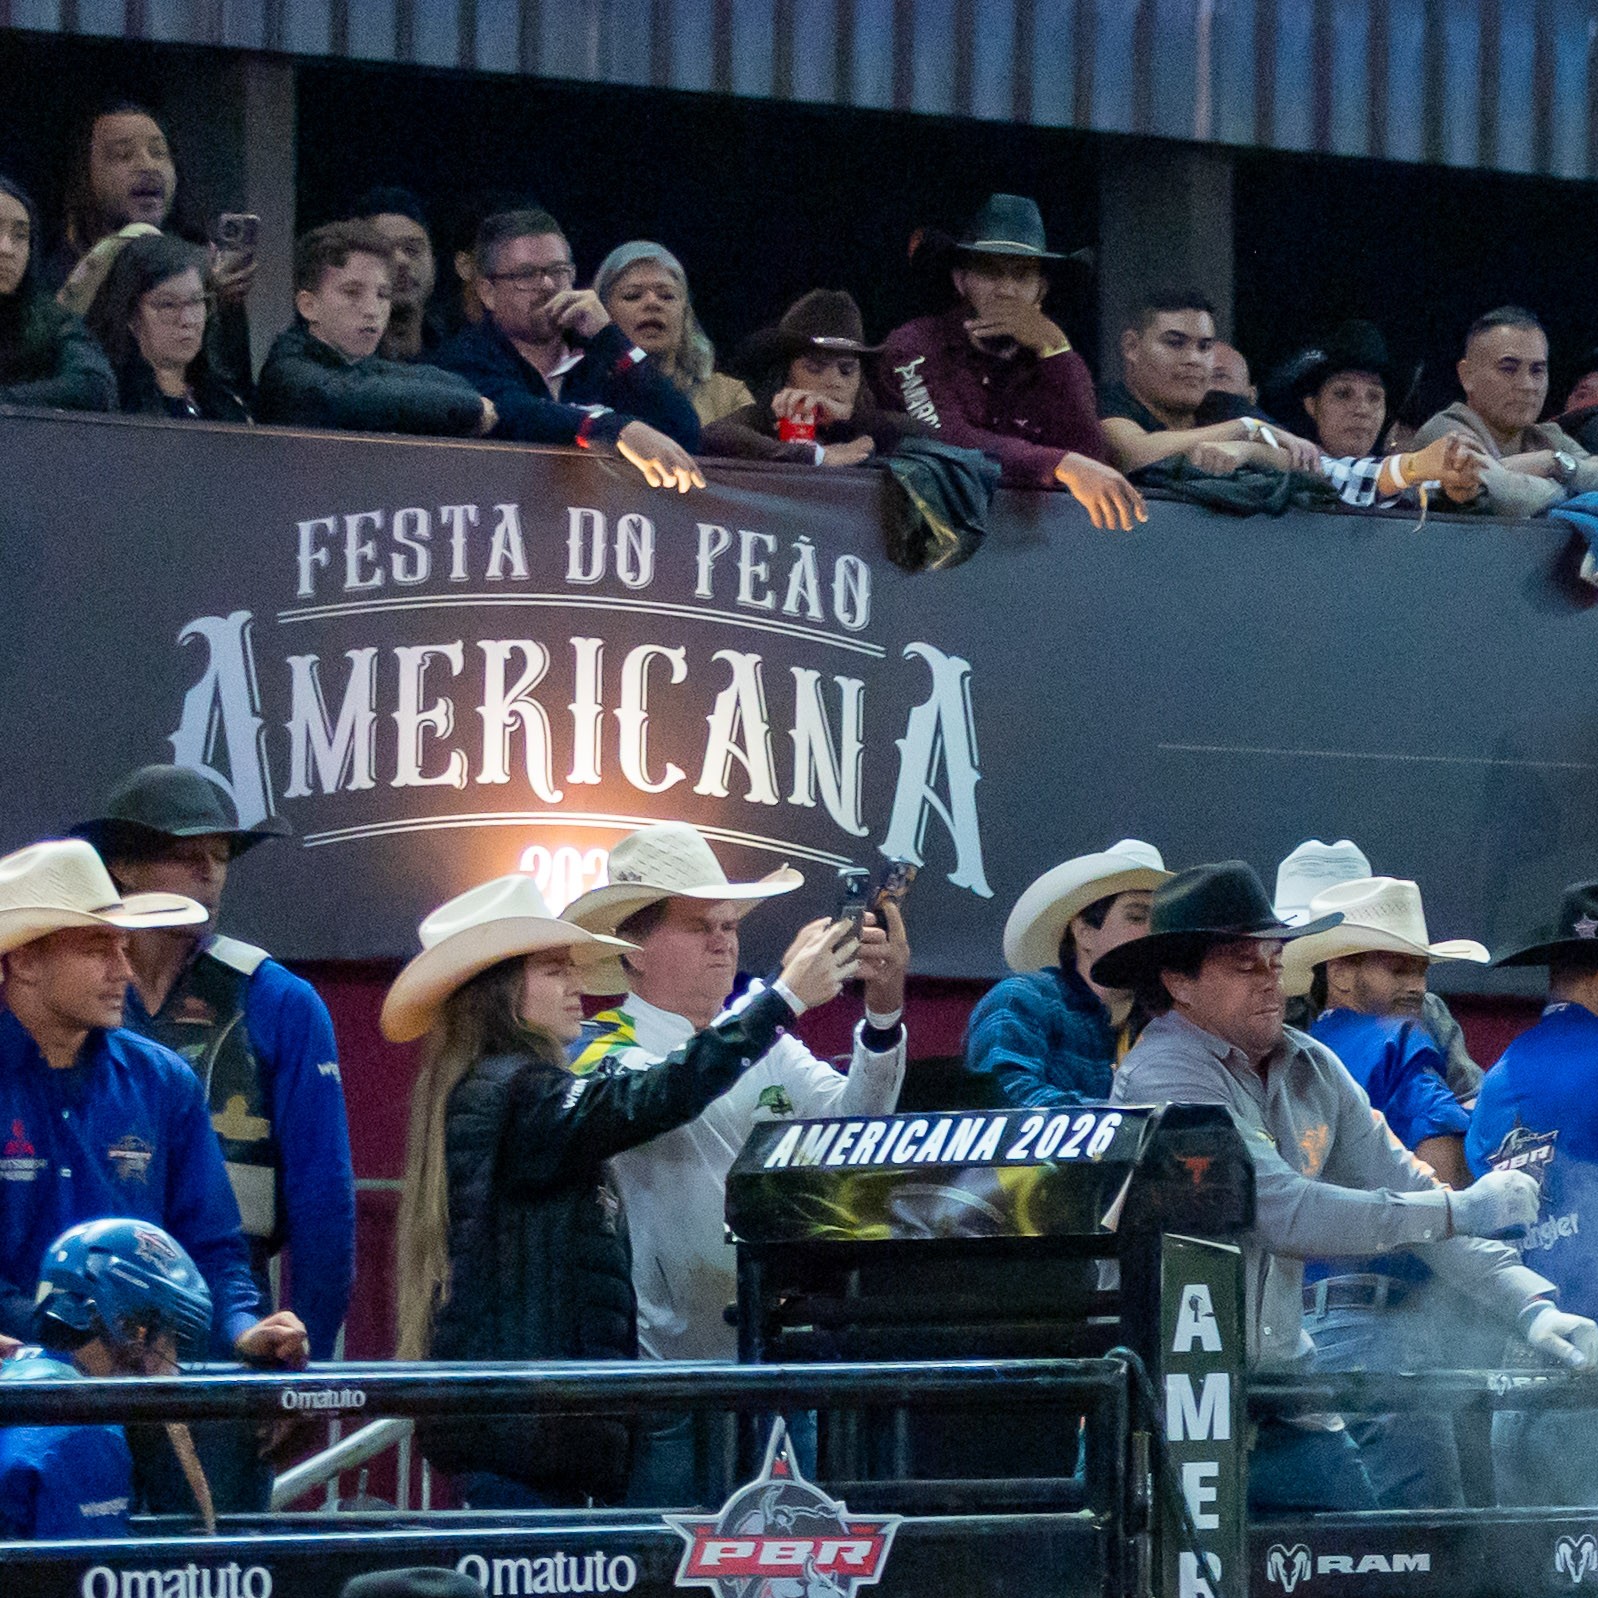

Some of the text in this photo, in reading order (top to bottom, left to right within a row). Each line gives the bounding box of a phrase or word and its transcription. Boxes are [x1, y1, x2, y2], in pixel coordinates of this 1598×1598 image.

[296, 503, 872, 632] FESTA DO PEÃO
[170, 609, 996, 899] AMERICANA
[520, 844, 610, 919] 202
[764, 1109, 1124, 1169] AMERICANA 2026
[281, 1387, 366, 1410] Omatuto
[456, 1551, 637, 1597] Omatuto
[699, 1537, 872, 1568] PBR
[1317, 1553, 1431, 1574] RAM
